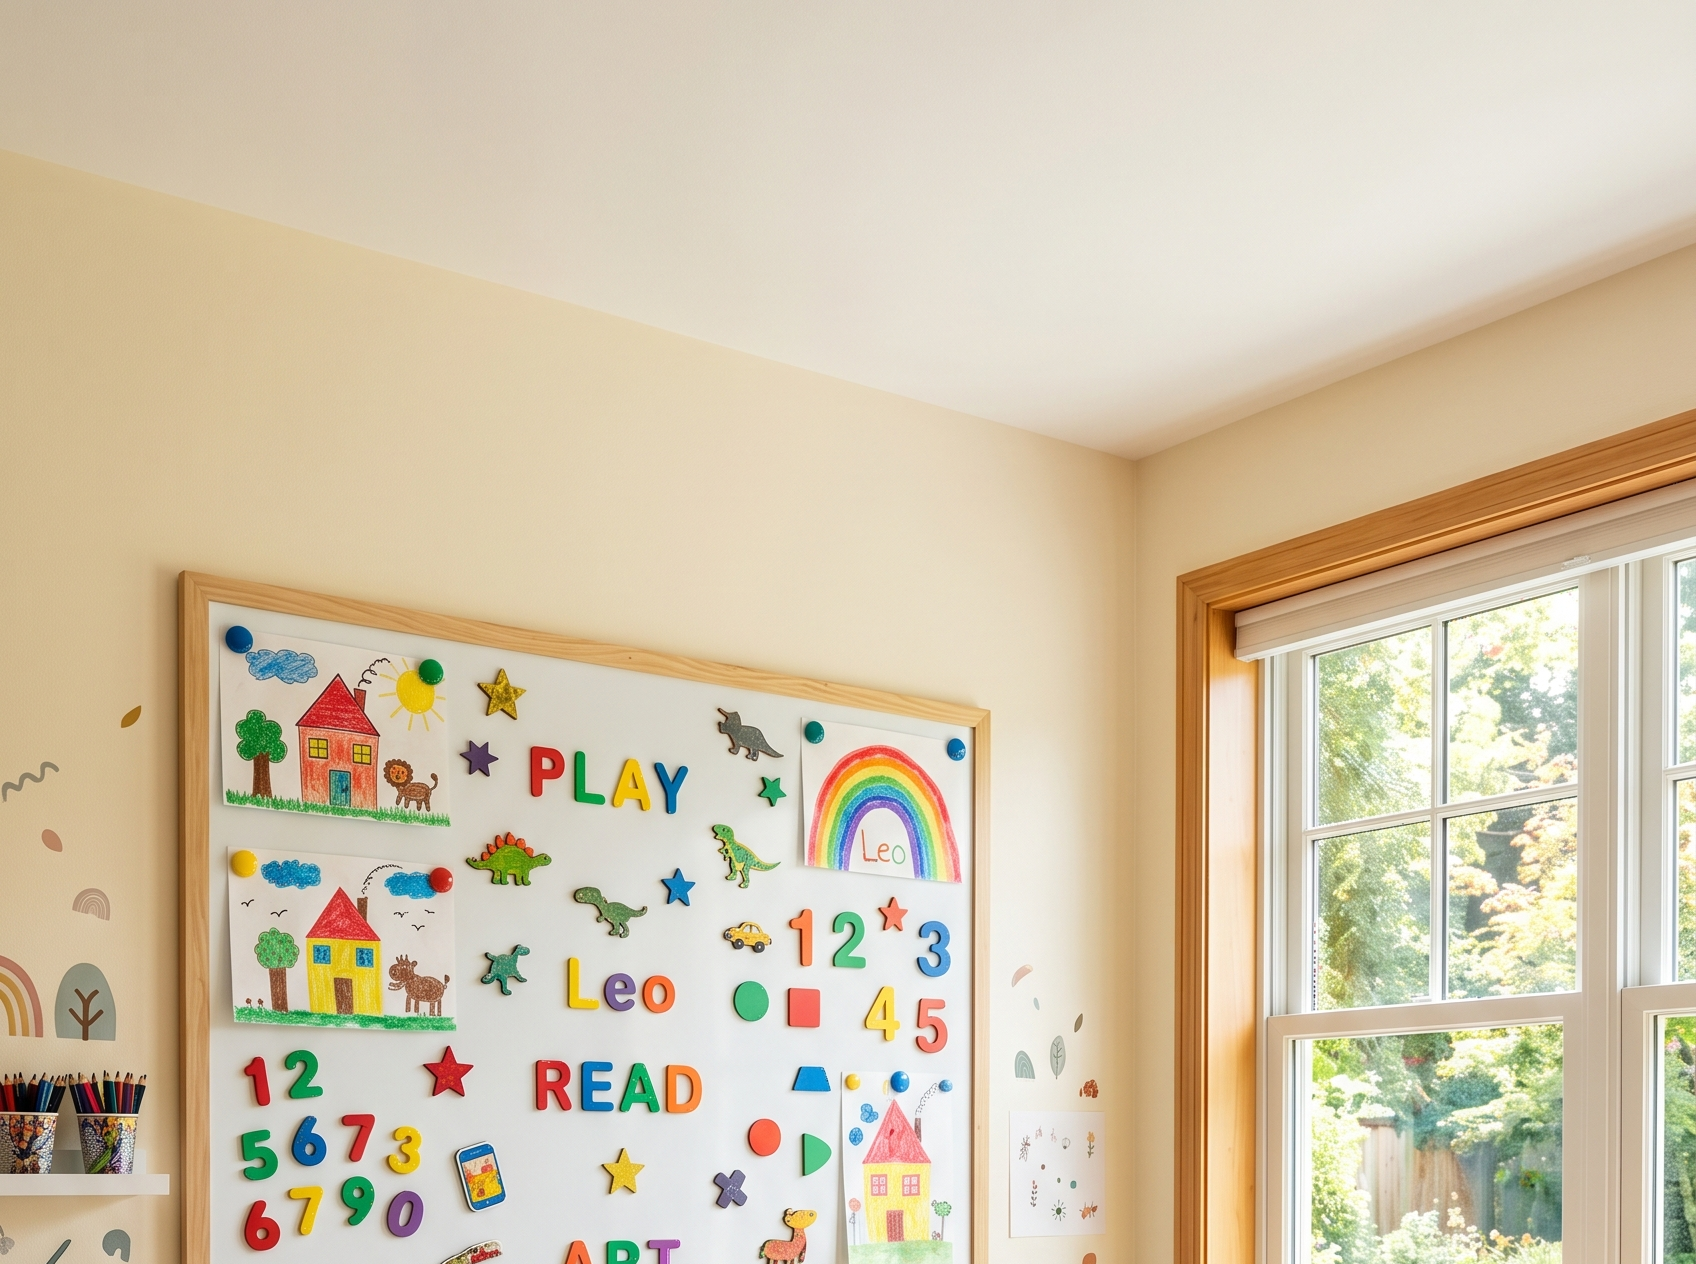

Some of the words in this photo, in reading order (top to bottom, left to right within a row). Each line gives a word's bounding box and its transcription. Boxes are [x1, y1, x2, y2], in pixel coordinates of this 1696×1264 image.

[529, 746, 689, 814] PLAY
[861, 829, 906, 865] Leo
[568, 957, 675, 1013] Leo
[535, 1060, 702, 1114] READ
